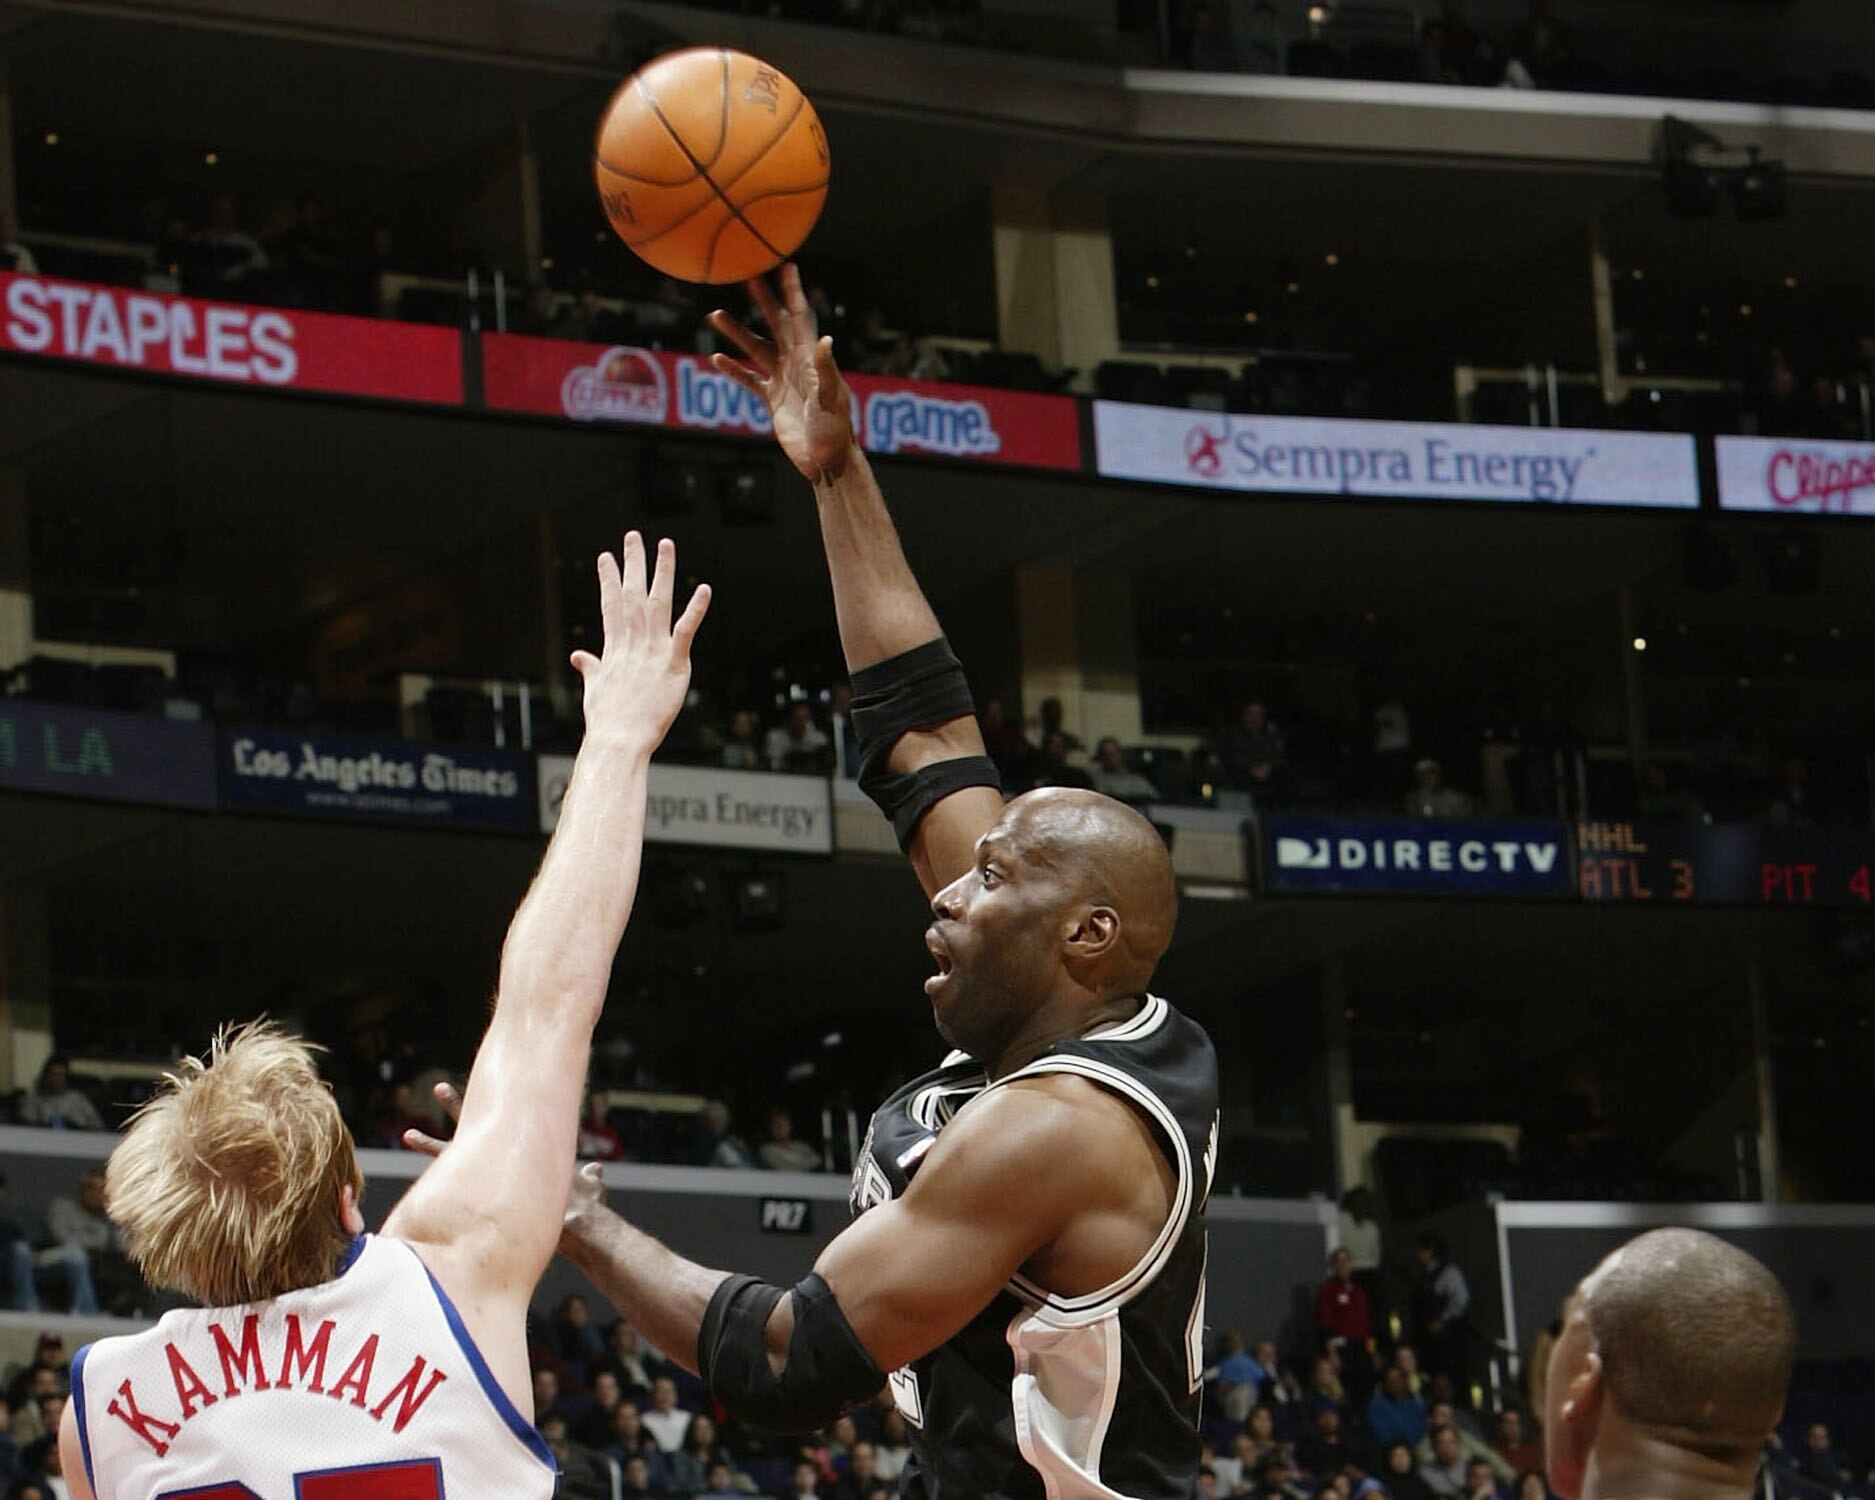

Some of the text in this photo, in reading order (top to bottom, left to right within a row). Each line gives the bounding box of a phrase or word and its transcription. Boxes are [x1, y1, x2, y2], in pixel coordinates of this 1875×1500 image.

[6, 278, 299, 385] STAPLES
[1232, 429, 1583, 503] Sempra Energy
[42, 720, 114, 776] LA
[232, 738, 518, 798] Los Angeles Times
[714, 792, 817, 838] Energy
[1338, 838, 1557, 873] DIRECTV
[1579, 858, 1694, 899] ATL 3
[1760, 862, 1871, 902] PIT 4
[107, 1313, 447, 1458] KAMMAN
